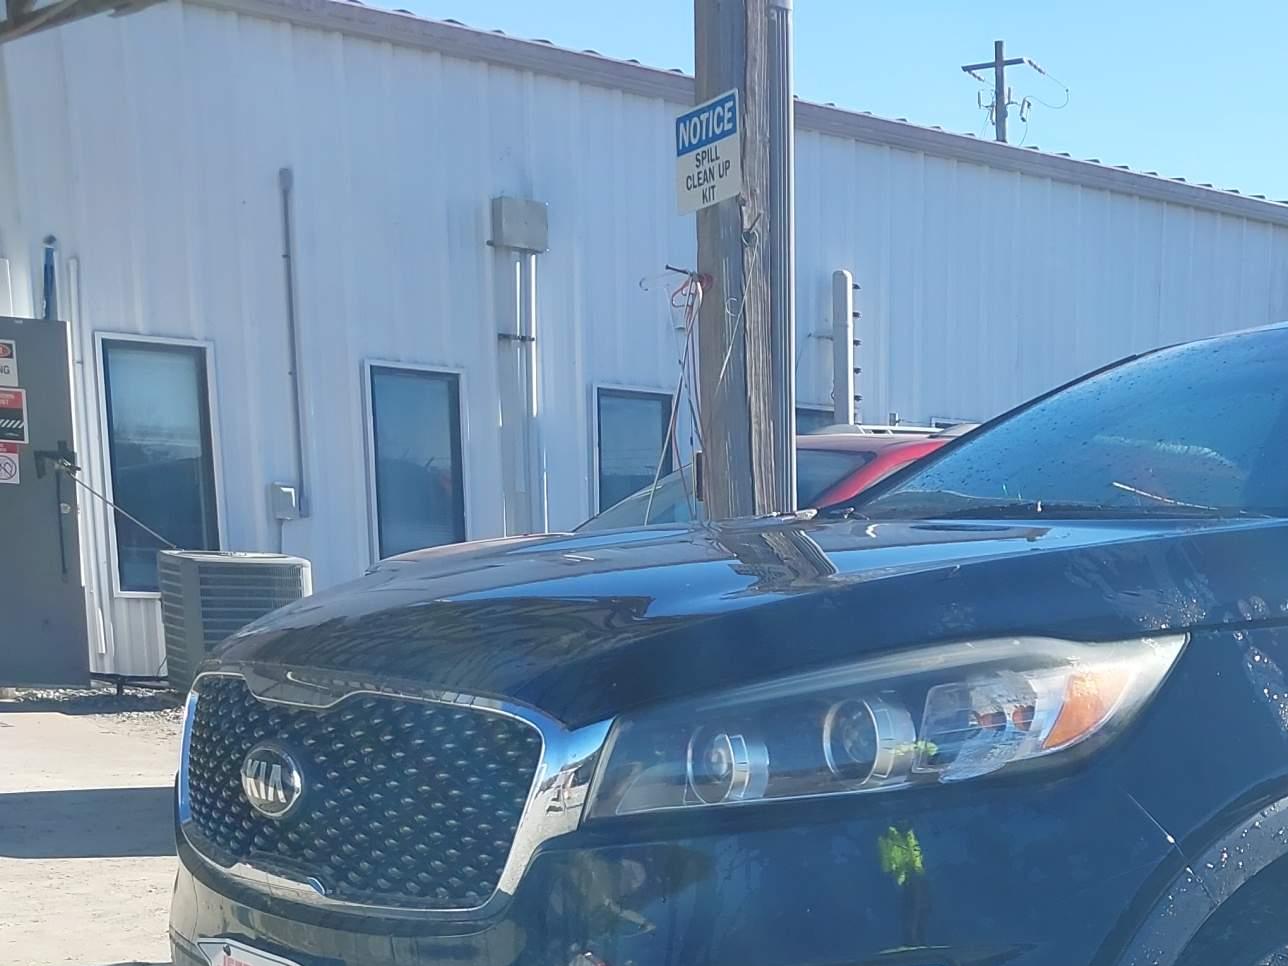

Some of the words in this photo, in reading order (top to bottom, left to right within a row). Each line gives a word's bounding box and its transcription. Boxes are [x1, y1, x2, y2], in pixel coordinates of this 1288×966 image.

[680, 101, 734, 150] NOTICE
[695, 145, 720, 168] SPILL
[686, 166, 715, 191] CLEAN
[718, 160, 731, 178] UP
[702, 185, 716, 204] KIT
[246, 758, 287, 804] KIA
